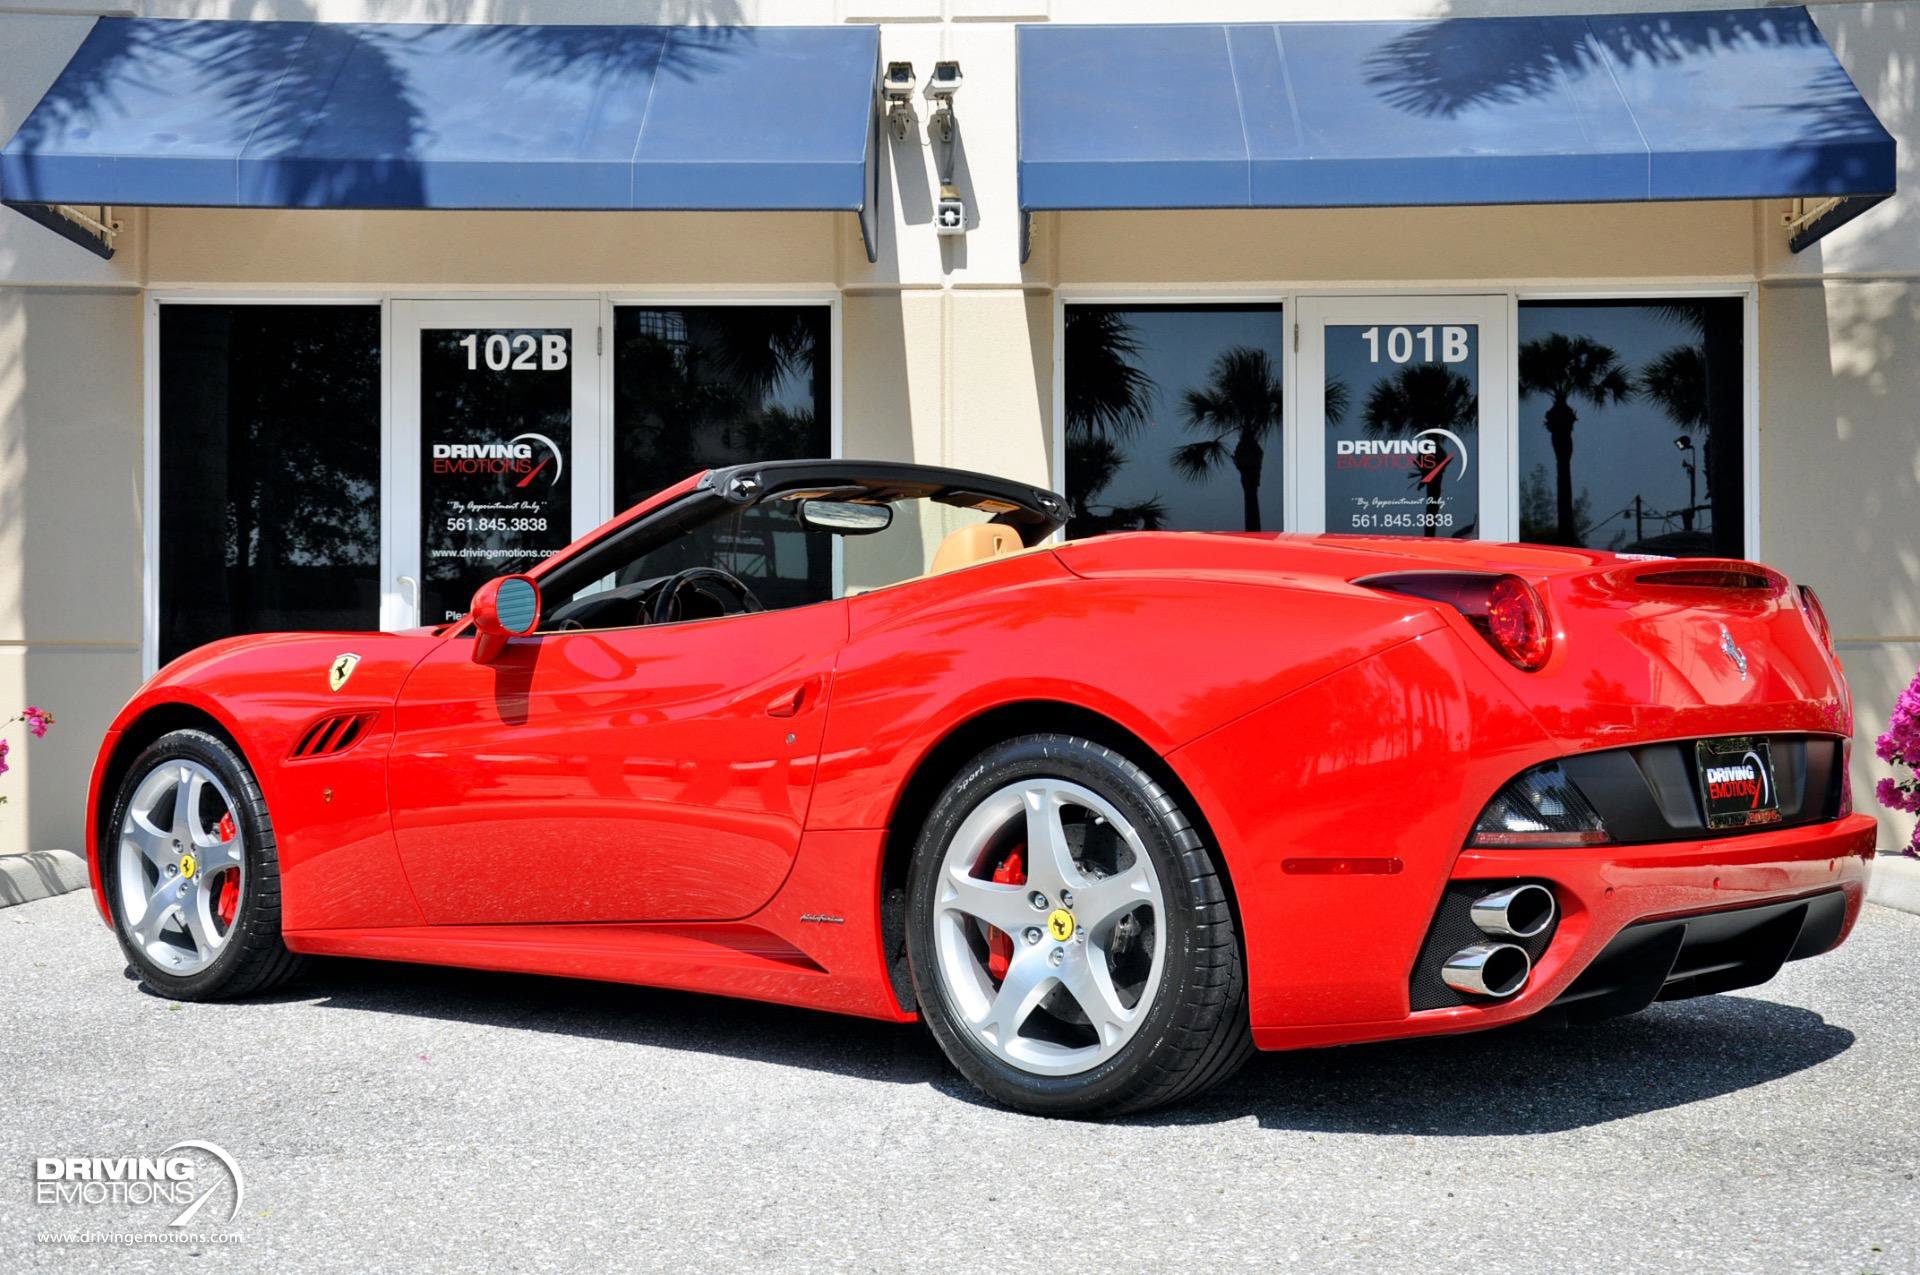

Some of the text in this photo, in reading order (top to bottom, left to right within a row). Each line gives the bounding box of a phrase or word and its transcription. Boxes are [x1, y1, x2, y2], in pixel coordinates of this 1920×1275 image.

[459, 334, 568, 371] 102B
[1362, 327, 1469, 363] 101B
[433, 444, 532, 459] DRIVING
[1336, 440, 1436, 455] DRIVING
[433, 459, 532, 474] EMOTIONS
[1336, 454, 1436, 471] EMOTIONS
[466, 500, 519, 512] Appointment
[1371, 496, 1425, 508] Appointment
[446, 518, 547, 531] 561.845.3838
[1351, 513, 1453, 527] 561.845.3838
[1706, 765, 1754, 783] DRIVING
[1709, 779, 1756, 799] EMOTIONS
